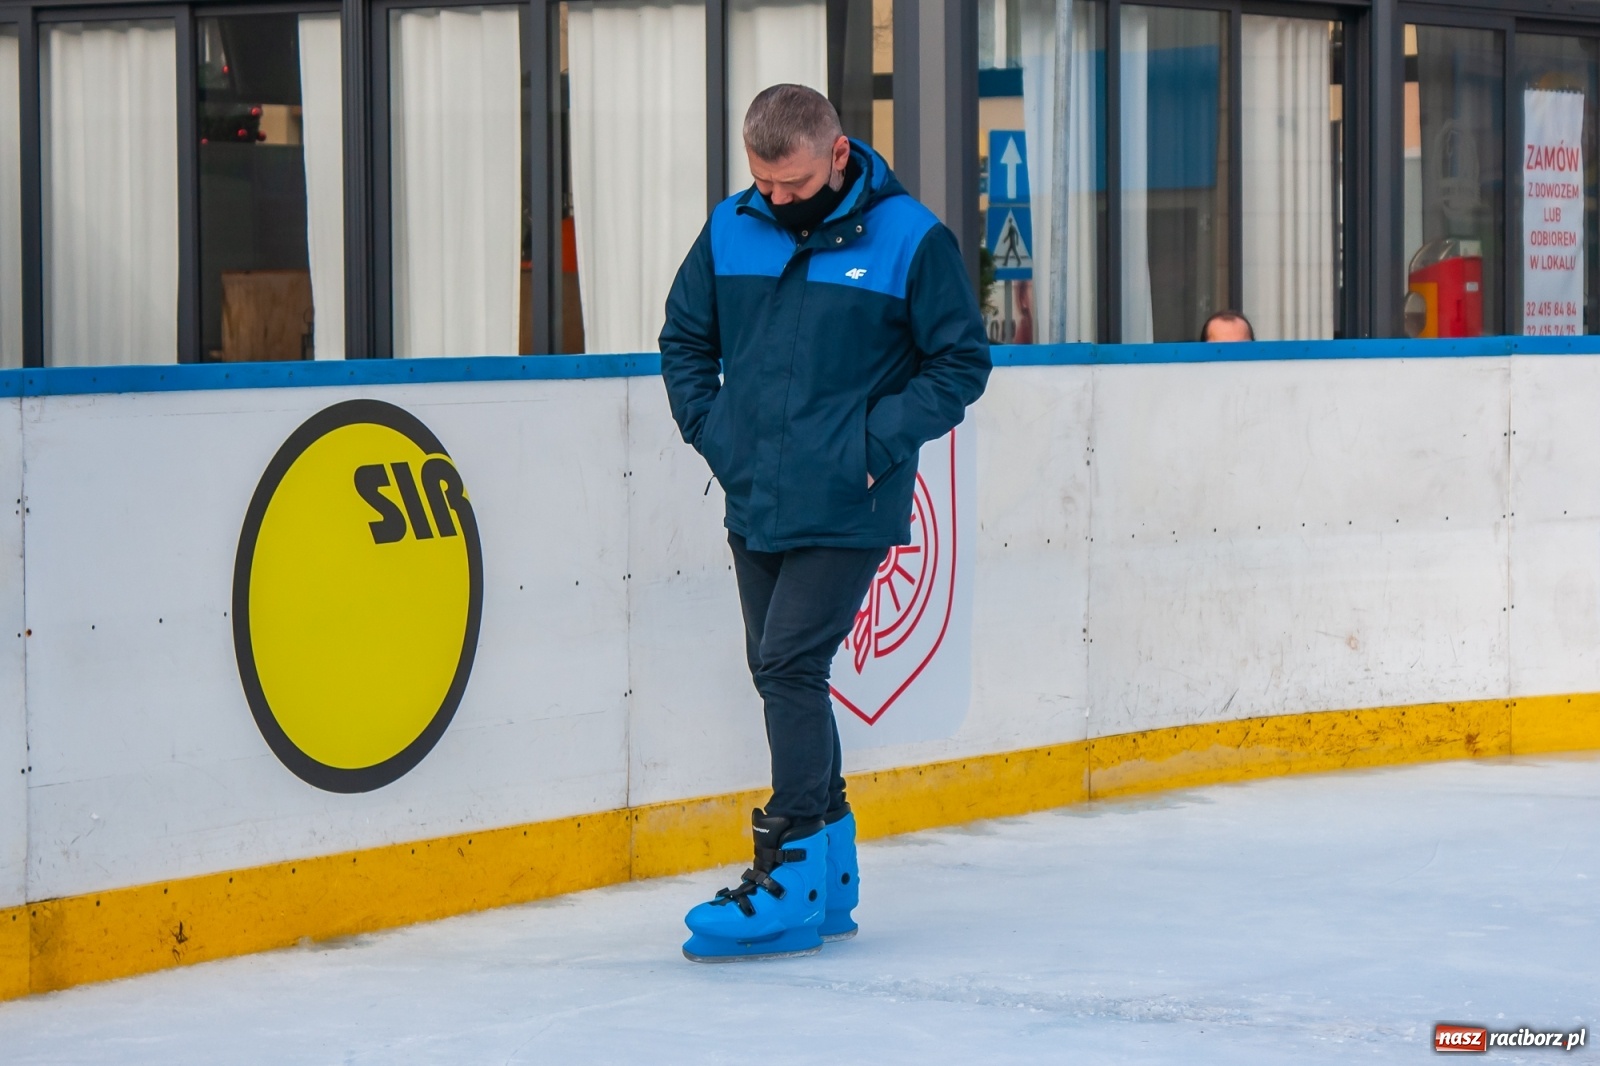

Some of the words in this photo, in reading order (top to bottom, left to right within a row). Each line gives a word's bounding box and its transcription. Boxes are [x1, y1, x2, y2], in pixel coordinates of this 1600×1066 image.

[1526, 139, 1579, 172] ZAMÓW
[1528, 182, 1533, 197] Z
[1535, 182, 1579, 199] DOWOZEM
[1543, 207, 1561, 222] LUB
[1530, 230, 1577, 247] ODBIOREM
[1530, 255, 1540, 270] W
[1541, 255, 1576, 270] LOKALU
[845, 267, 867, 280] 4F
[1526, 301, 1536, 316] 32
[1538, 301, 1551, 316] 415
[1554, 301, 1564, 316] 84
[1566, 301, 1577, 316] 84
